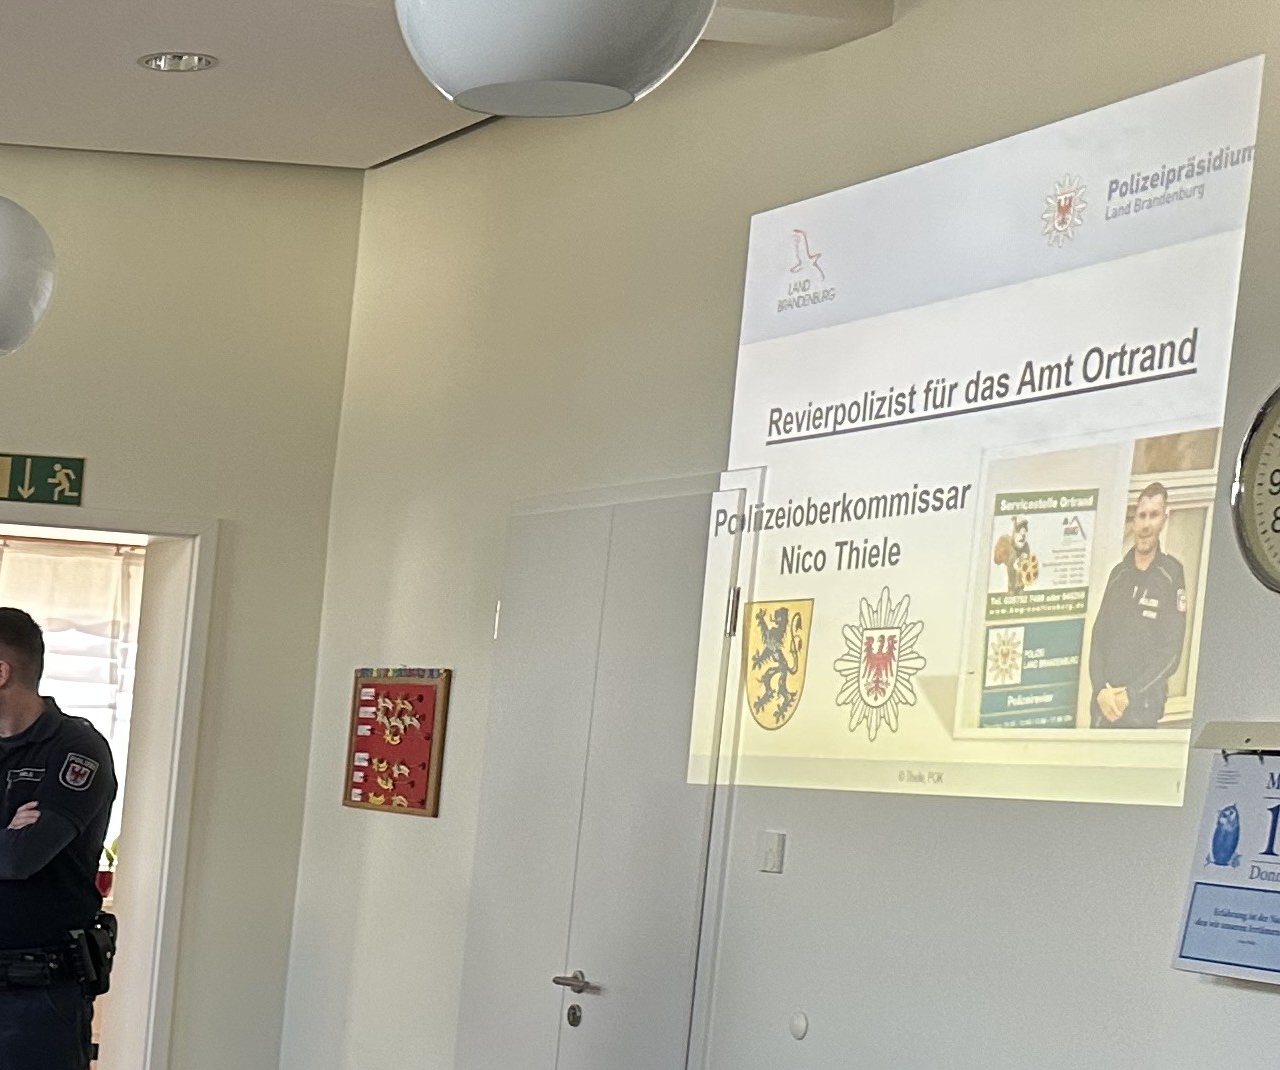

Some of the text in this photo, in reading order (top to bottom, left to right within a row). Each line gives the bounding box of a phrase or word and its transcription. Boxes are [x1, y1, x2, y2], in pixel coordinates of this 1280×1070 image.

[1105, 184, 1205, 220] Land Brandenburg
[768, 327, 1199, 437] Revierpolizist für das Amt Ortrand
[714, 483, 972, 537] Polizeioberkommissar
[780, 536, 901, 575] Nico Thiele
